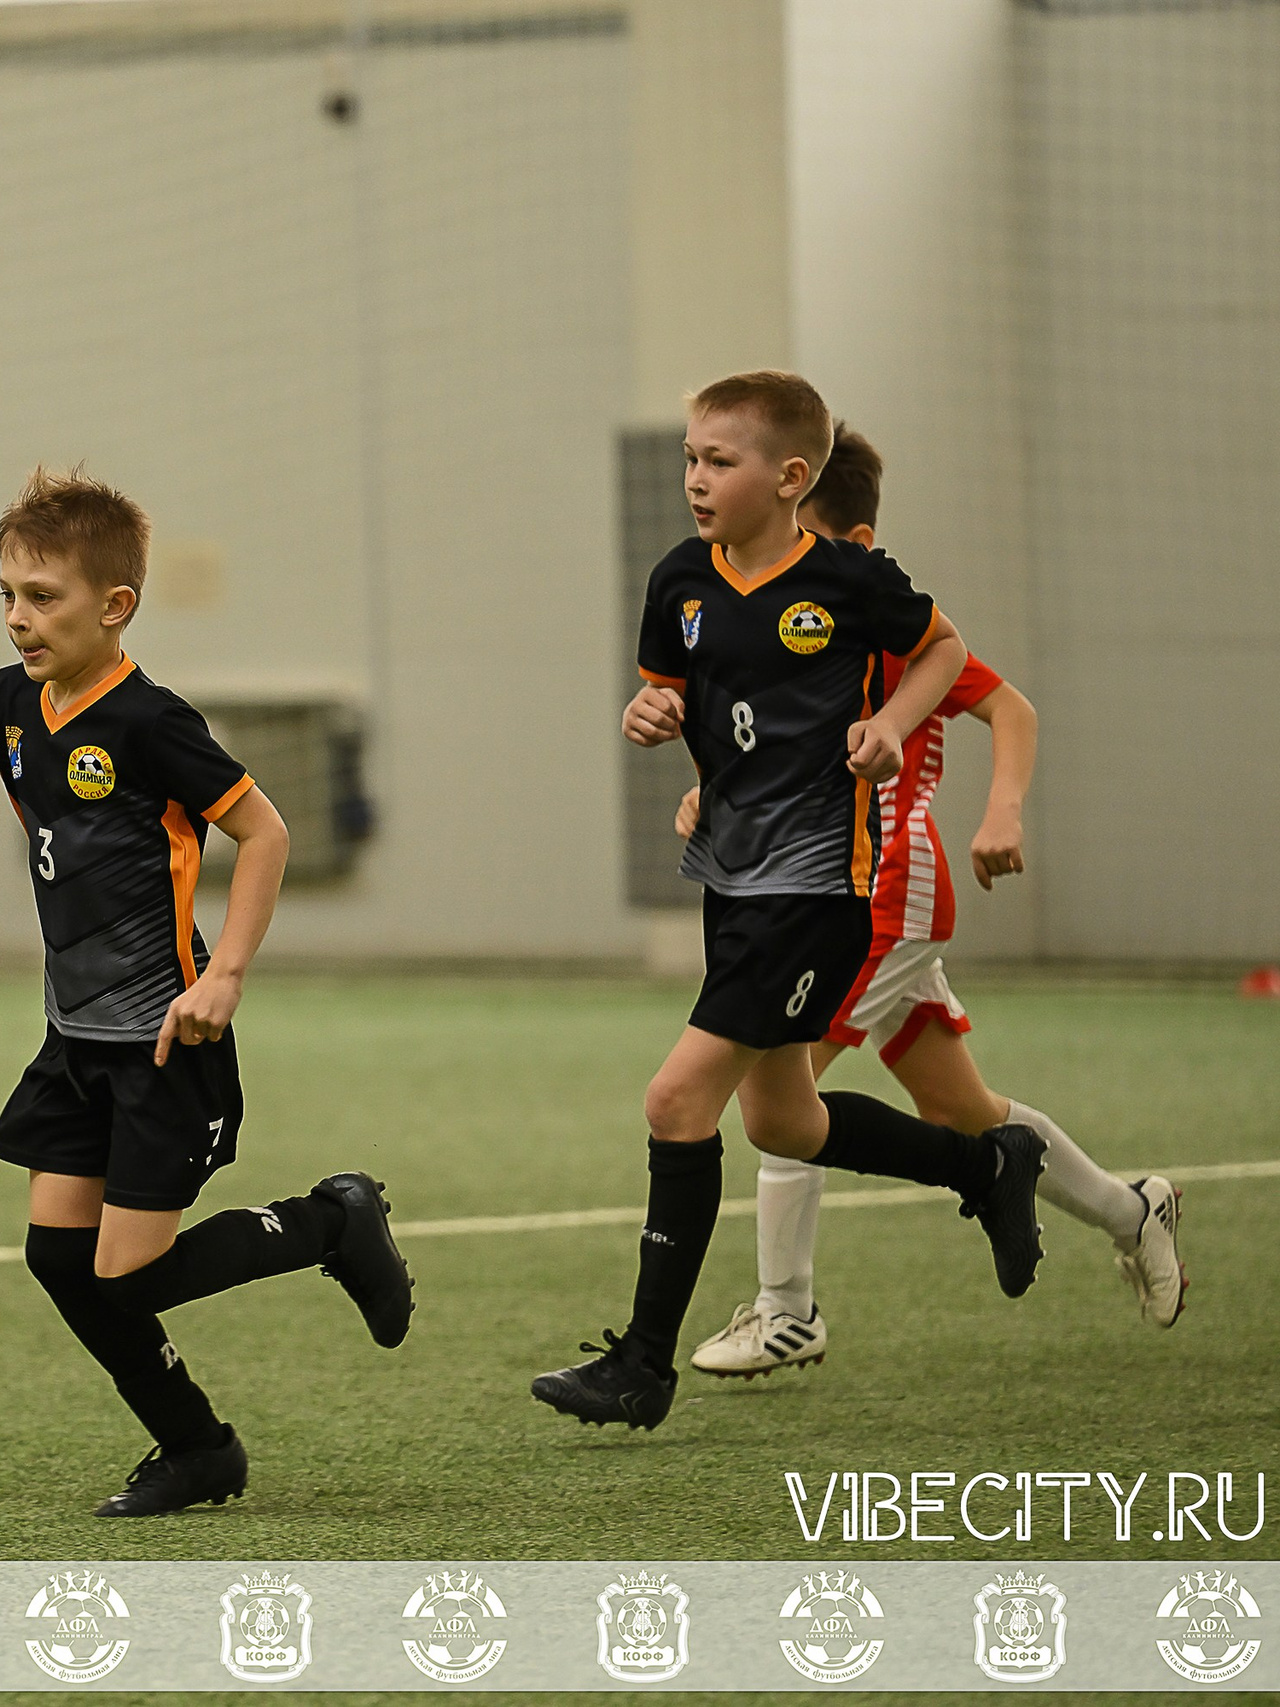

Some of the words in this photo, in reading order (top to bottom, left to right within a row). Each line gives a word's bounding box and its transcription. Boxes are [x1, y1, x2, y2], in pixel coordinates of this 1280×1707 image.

[786, 639, 825, 653] РОССИЯ
[731, 700, 757, 753] 8
[69, 770, 113, 785] ОЛИМПИЯ
[73, 784, 109, 799] РОССИЯ
[38, 827, 55, 881] 3
[786, 970, 815, 1017] 8
